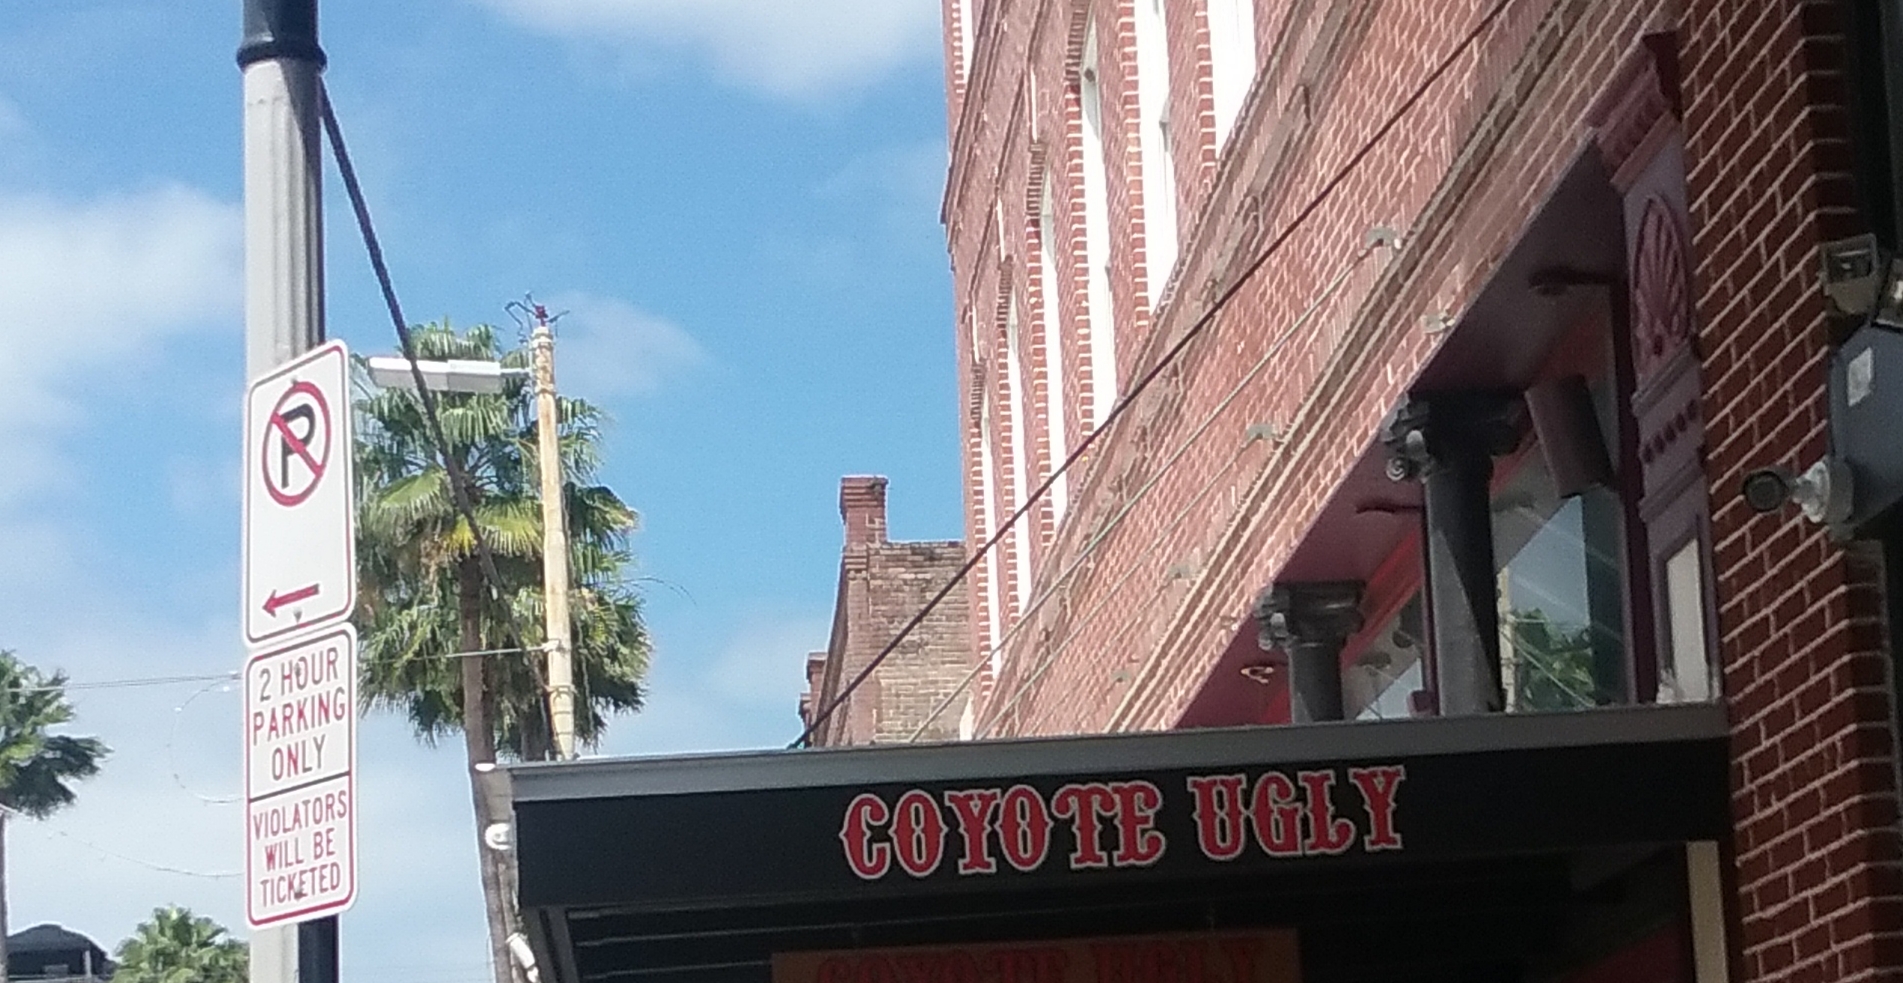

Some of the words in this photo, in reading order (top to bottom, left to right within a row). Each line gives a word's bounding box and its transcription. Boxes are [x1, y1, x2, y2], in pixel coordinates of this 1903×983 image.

[258, 667, 271, 703] 2
[280, 650, 339, 696] HOUR
[253, 686, 346, 747] PARKING
[271, 733, 327, 782] ONLY
[253, 790, 347, 841] VIOLATORS
[839, 781, 1166, 879] COYOTE
[1187, 765, 1406, 860] UGLY
[265, 836, 305, 870] WILL
[312, 826, 337, 859] BE
[260, 862, 341, 908] TICKETED
